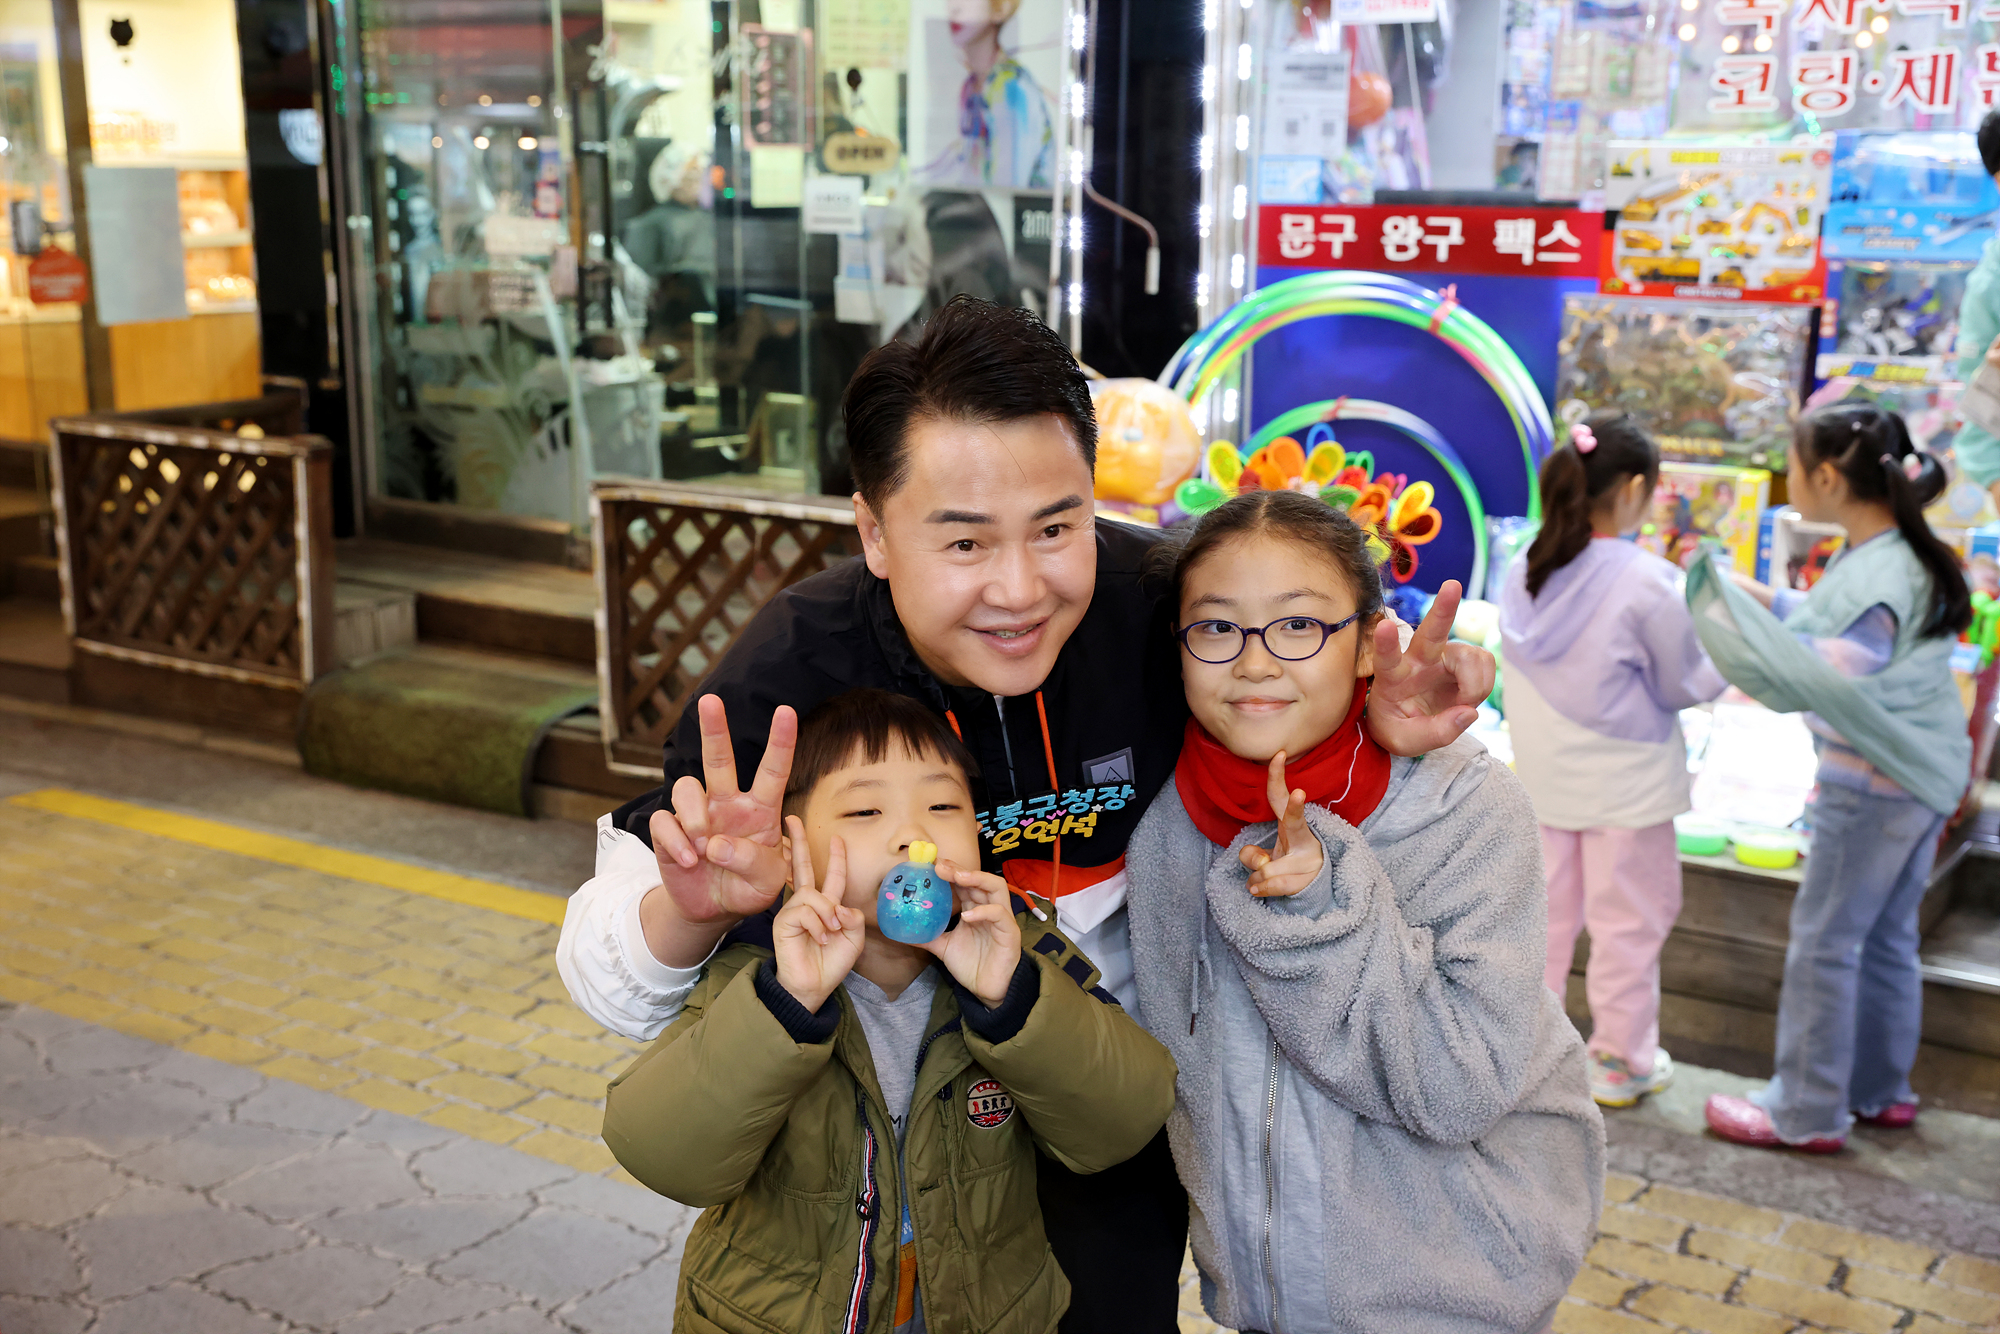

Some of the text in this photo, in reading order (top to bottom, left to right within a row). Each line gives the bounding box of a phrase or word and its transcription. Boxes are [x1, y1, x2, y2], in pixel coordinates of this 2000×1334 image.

[1277, 212, 1582, 266] 문구 완구 팩스
